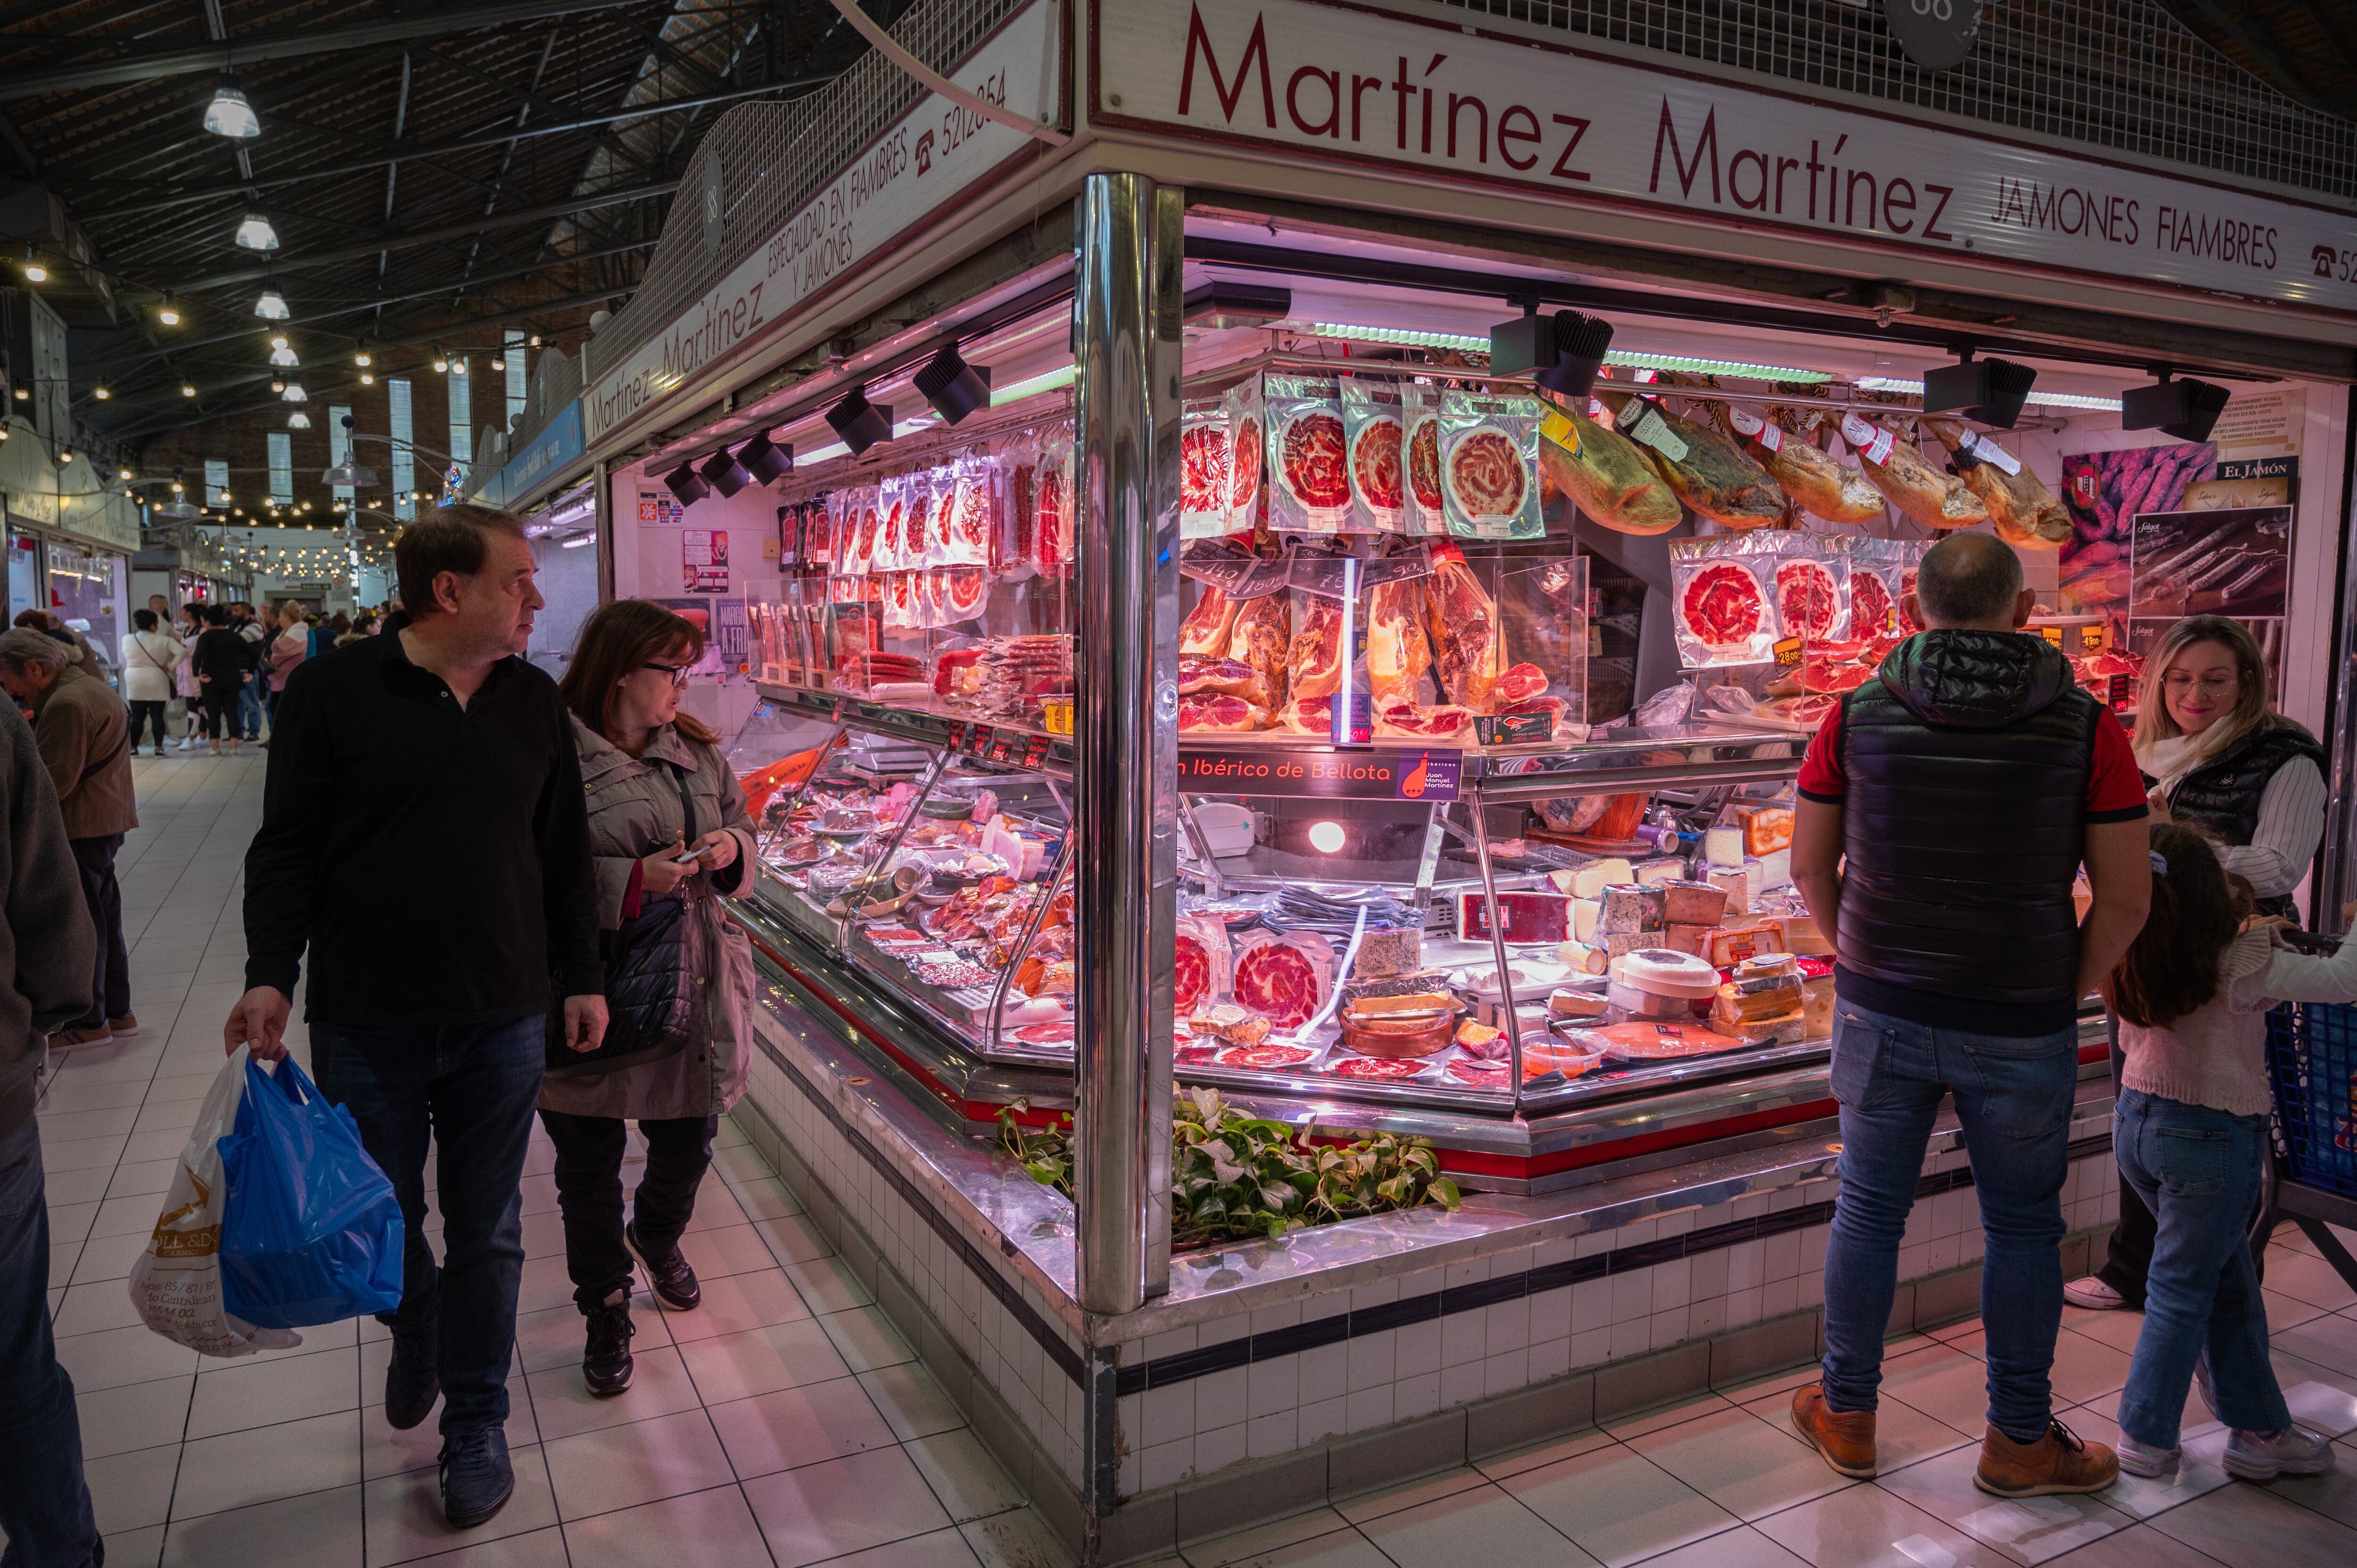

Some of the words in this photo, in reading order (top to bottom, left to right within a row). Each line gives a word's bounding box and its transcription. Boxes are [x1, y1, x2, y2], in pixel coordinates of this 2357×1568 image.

[1178, 0, 1591, 182] Martínez
[1648, 94, 1954, 242] Martínez
[1990, 176, 2140, 246] JAMONES
[2157, 205, 2278, 270] FIAMBRES
[768, 200, 825, 278] ESPECIALIDAD
[831, 181, 845, 229] EN
[851, 126, 907, 213] FIAMBRES
[793, 262, 799, 299] Y
[803, 221, 852, 292] JAMONES
[593, 369, 651, 438] Martínez
[663, 281, 764, 389] Martínez
[2137, 522, 2160, 533] Salgot
[1216, 546, 1238, 559] BELLOTA
[1205, 562, 1238, 580] 140
[1393, 563, 1417, 577] 90
[1242, 577, 1275, 595] 180
[2132, 625, 2154, 636] Salgot
[722, 627, 728, 654] A
[1193, 759, 1269, 777] Ibérico
[1277, 759, 1304, 778] de
[1311, 761, 1391, 780] Bellota
[165, 1281, 178, 1291] 85
[186, 1284, 198, 1293] 87
